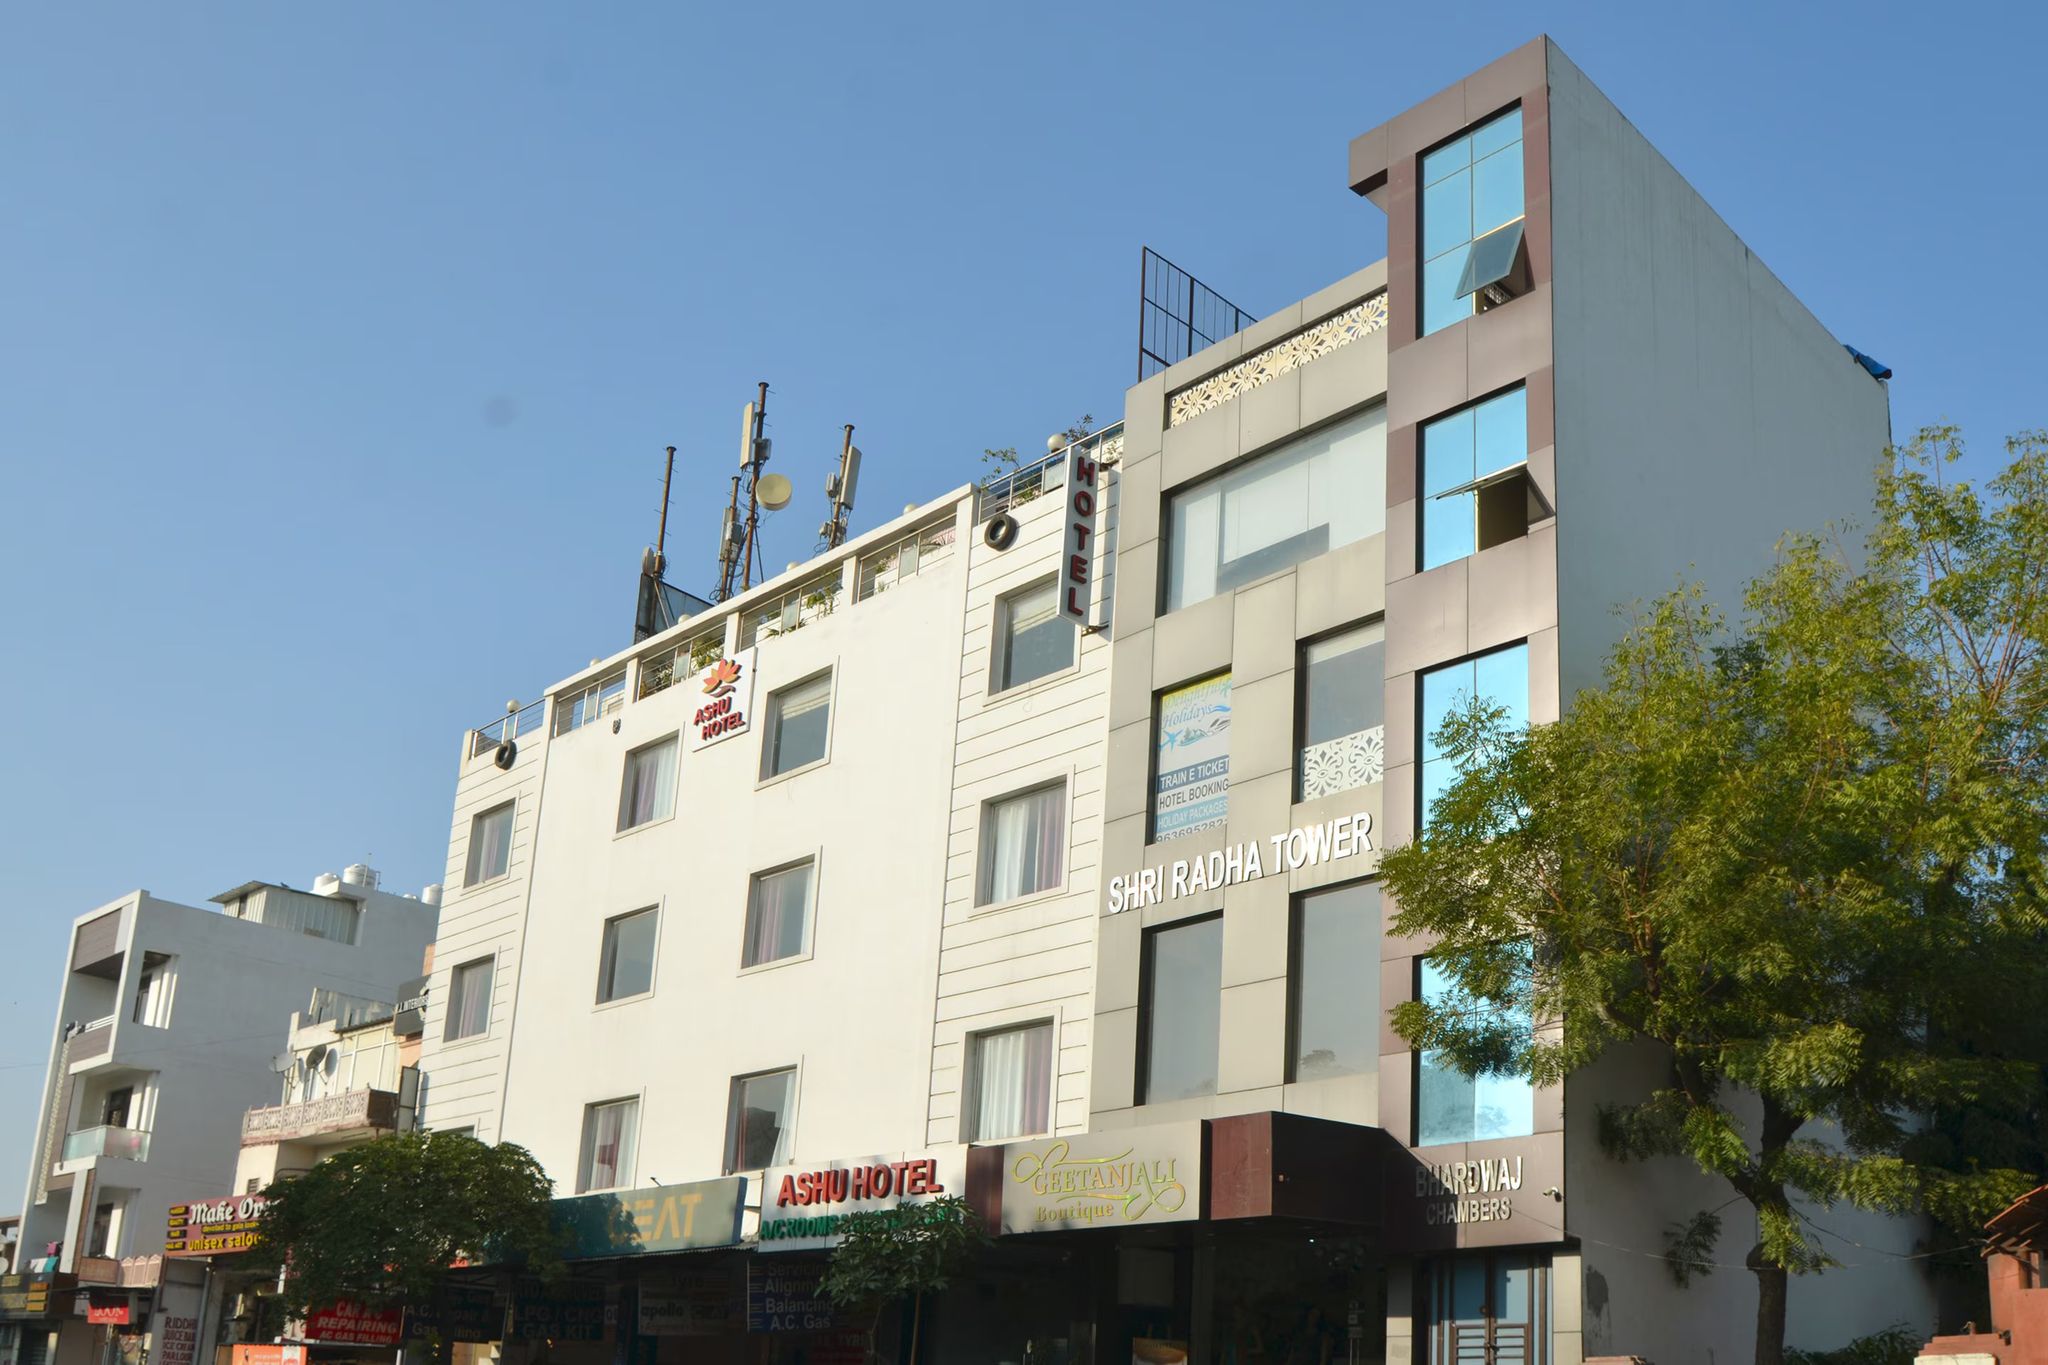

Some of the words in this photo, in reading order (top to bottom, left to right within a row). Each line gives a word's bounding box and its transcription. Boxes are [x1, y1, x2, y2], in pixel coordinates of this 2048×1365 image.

[1068, 456, 1095, 617] HOTEL
[694, 696, 732, 726] ASHU
[1162, 702, 1213, 729] Holidays
[702, 711, 746, 741] HOTEL
[1160, 773, 1187, 789] TRAIN
[1189, 768, 1195, 781] E
[1197, 758, 1230, 777] TICKET
[1159, 792, 1187, 810] HOTEL
[1189, 778, 1230, 801] BOOKING
[1158, 811, 1189, 829] HOLIDAY
[1189, 799, 1229, 818] PACKAGES
[1108, 864, 1165, 914] SHRI
[1171, 840, 1264, 899] RADHA
[1271, 811, 1373, 873] TOWER
[777, 1169, 849, 1207] ASHU
[851, 1159, 944, 1200] HOTEL
[1033, 1158, 1177, 1195] GEETANJALI
[1415, 1155, 1523, 1197] BHARDWAJ
[189, 1201, 234, 1224] Make
[608, 1194, 703, 1246] CEAT
[1036, 1200, 1114, 1224] Boutique
[1426, 1197, 1512, 1224] CHAMBERS
[760, 1219, 786, 1240] A/C
[787, 1215, 839, 1238] ROOMS
[188, 1236, 224, 1251] unisex
[764, 1277, 820, 1296] Alignm
[765, 1297, 835, 1315] Balancing
[317, 1316, 397, 1335] REPAIRING
[769, 1315, 799, 1331] A.C.
[803, 1313, 832, 1330] Gas
[319, 1330, 334, 1340] AC
[335, 1331, 354, 1342] GAS
[355, 1332, 394, 1344] FILLING
